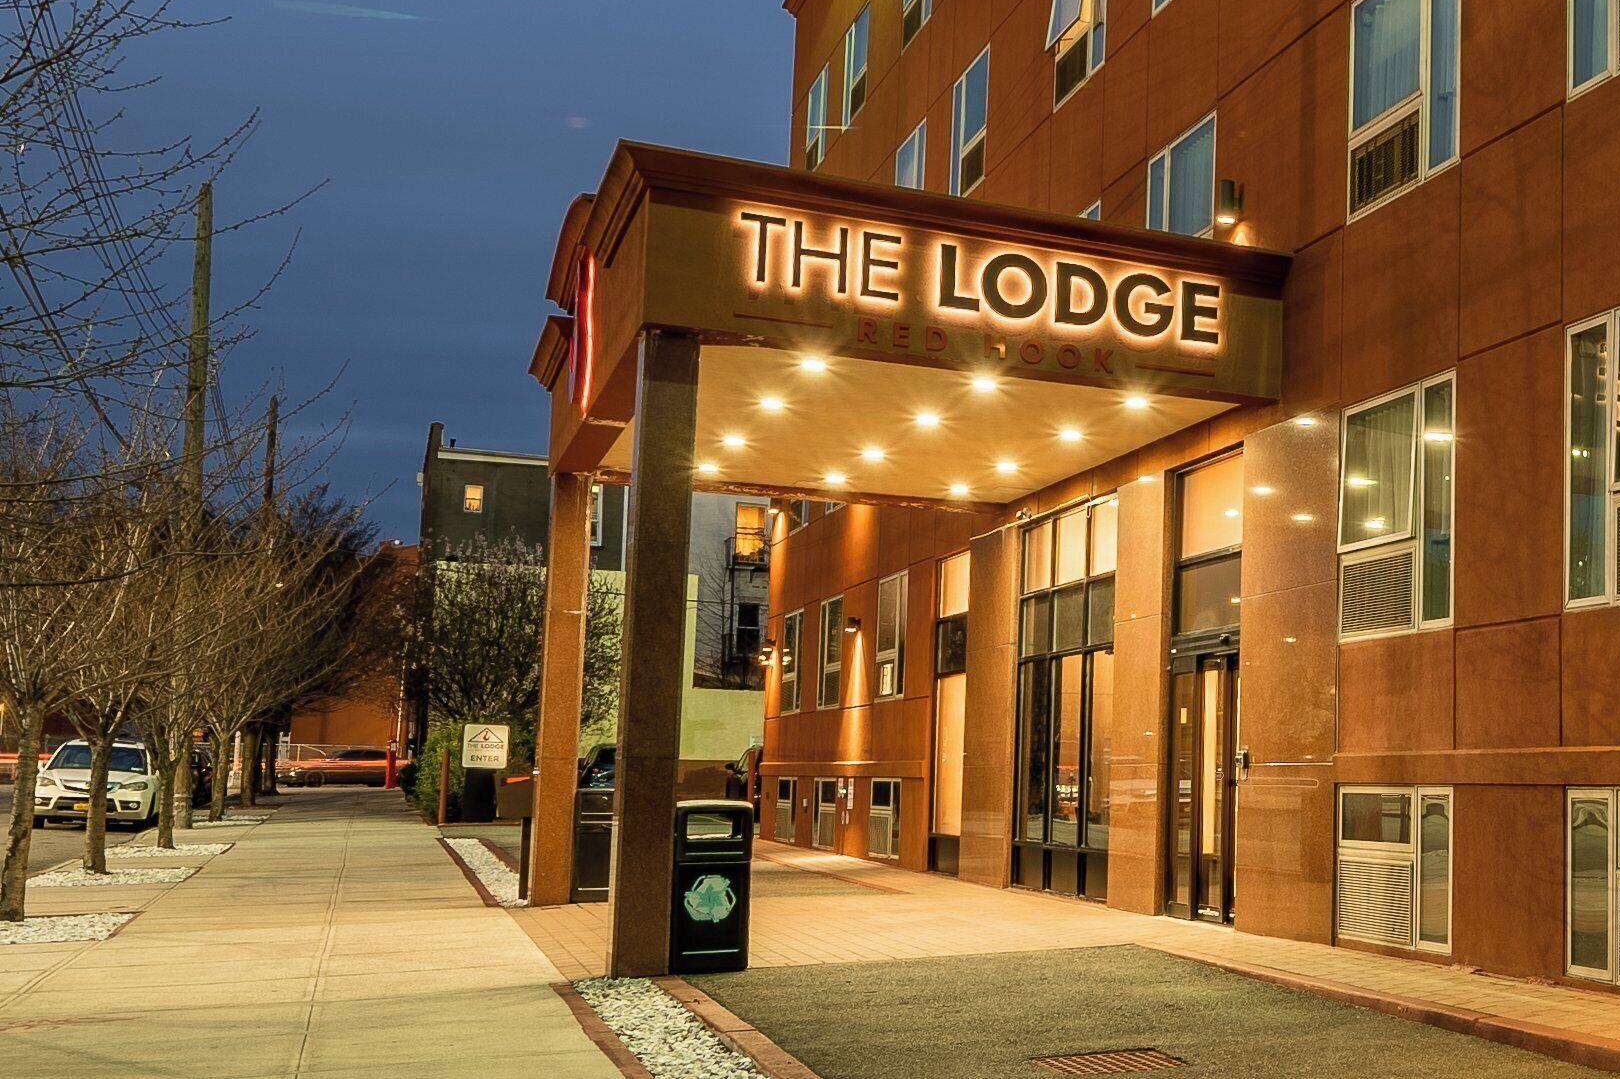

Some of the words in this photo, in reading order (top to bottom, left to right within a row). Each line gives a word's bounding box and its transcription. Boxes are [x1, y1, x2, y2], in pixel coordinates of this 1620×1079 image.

[740, 212, 902, 301] THE
[938, 243, 1221, 344] LODGE
[857, 317, 948, 352] RED
[983, 333, 1116, 375] HOOK
[470, 754, 500, 763] ENTER
